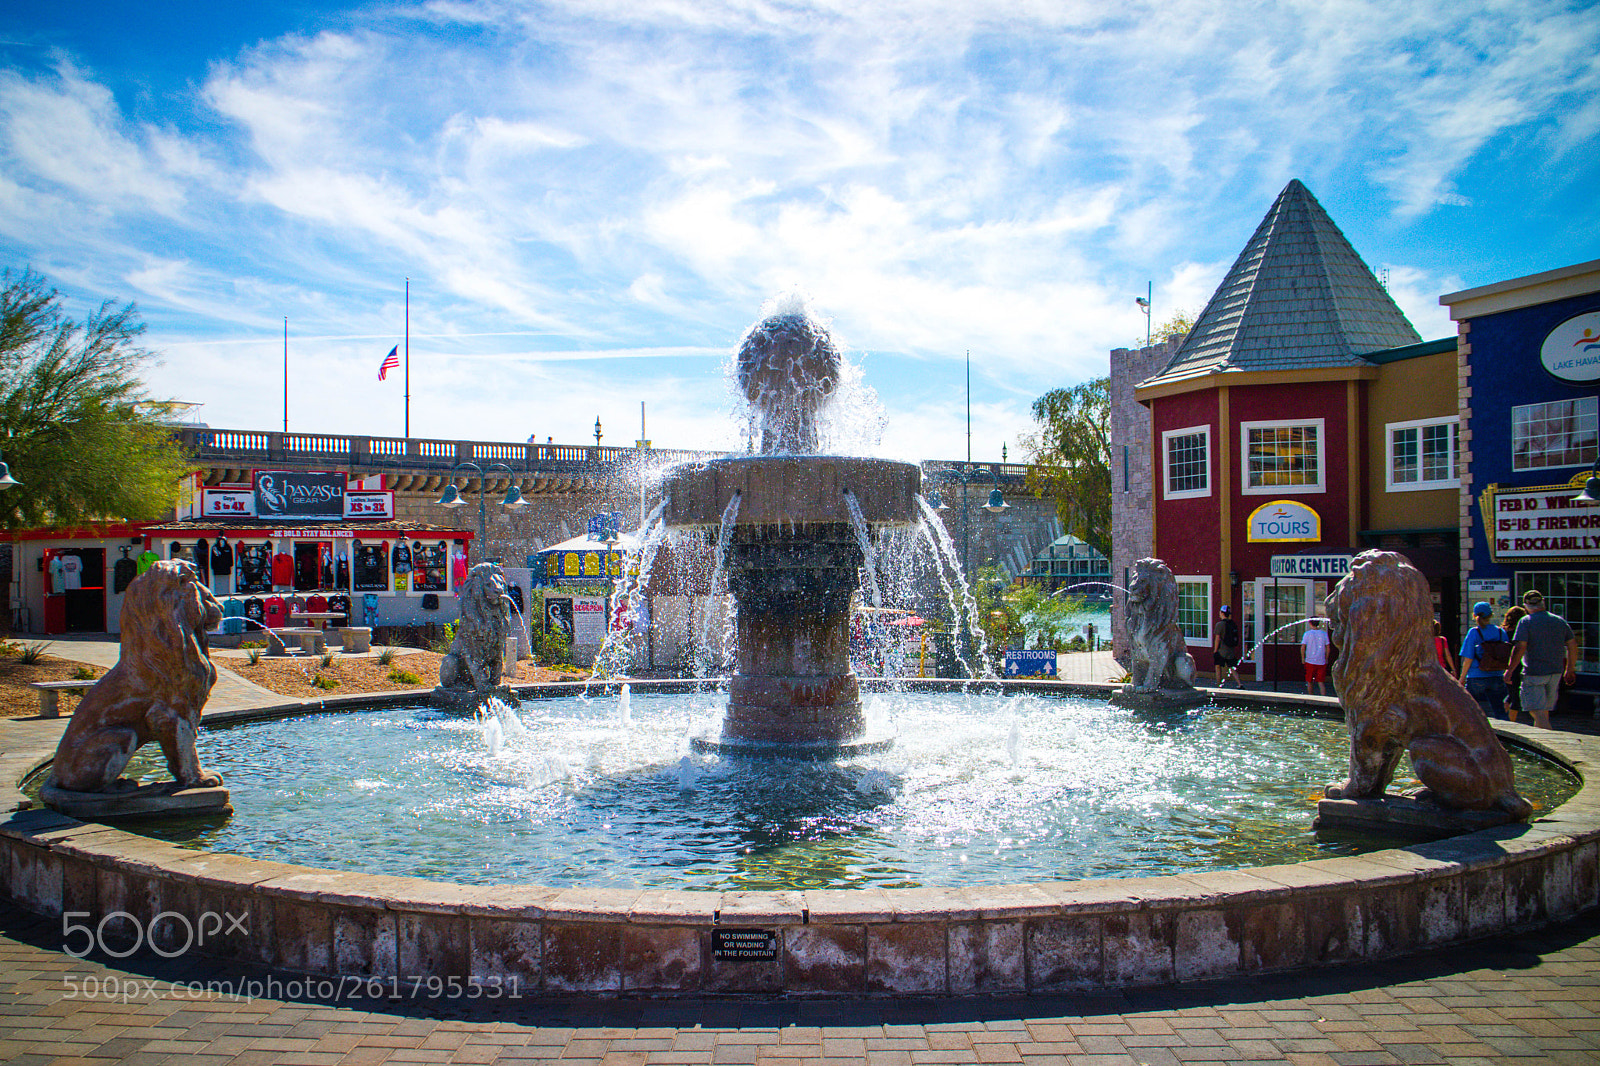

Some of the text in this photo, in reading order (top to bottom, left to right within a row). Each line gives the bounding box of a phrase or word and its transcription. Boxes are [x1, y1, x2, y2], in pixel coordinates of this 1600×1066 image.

[1554, 356, 1600, 370] LAKE HAVA
[214, 500, 222, 510] S
[232, 502, 244, 510] 4X
[350, 502, 362, 512] XS
[374, 502, 384, 512] 3X
[1500, 500, 1520, 512] FEB
[1258, 522, 1310, 534] TOURS
[1498, 518, 1530, 532] 15-18
[1496, 538, 1510, 550] 16
[1300, 558, 1348, 574] CENTER
[1006, 650, 1056, 660] RESTROOMS
